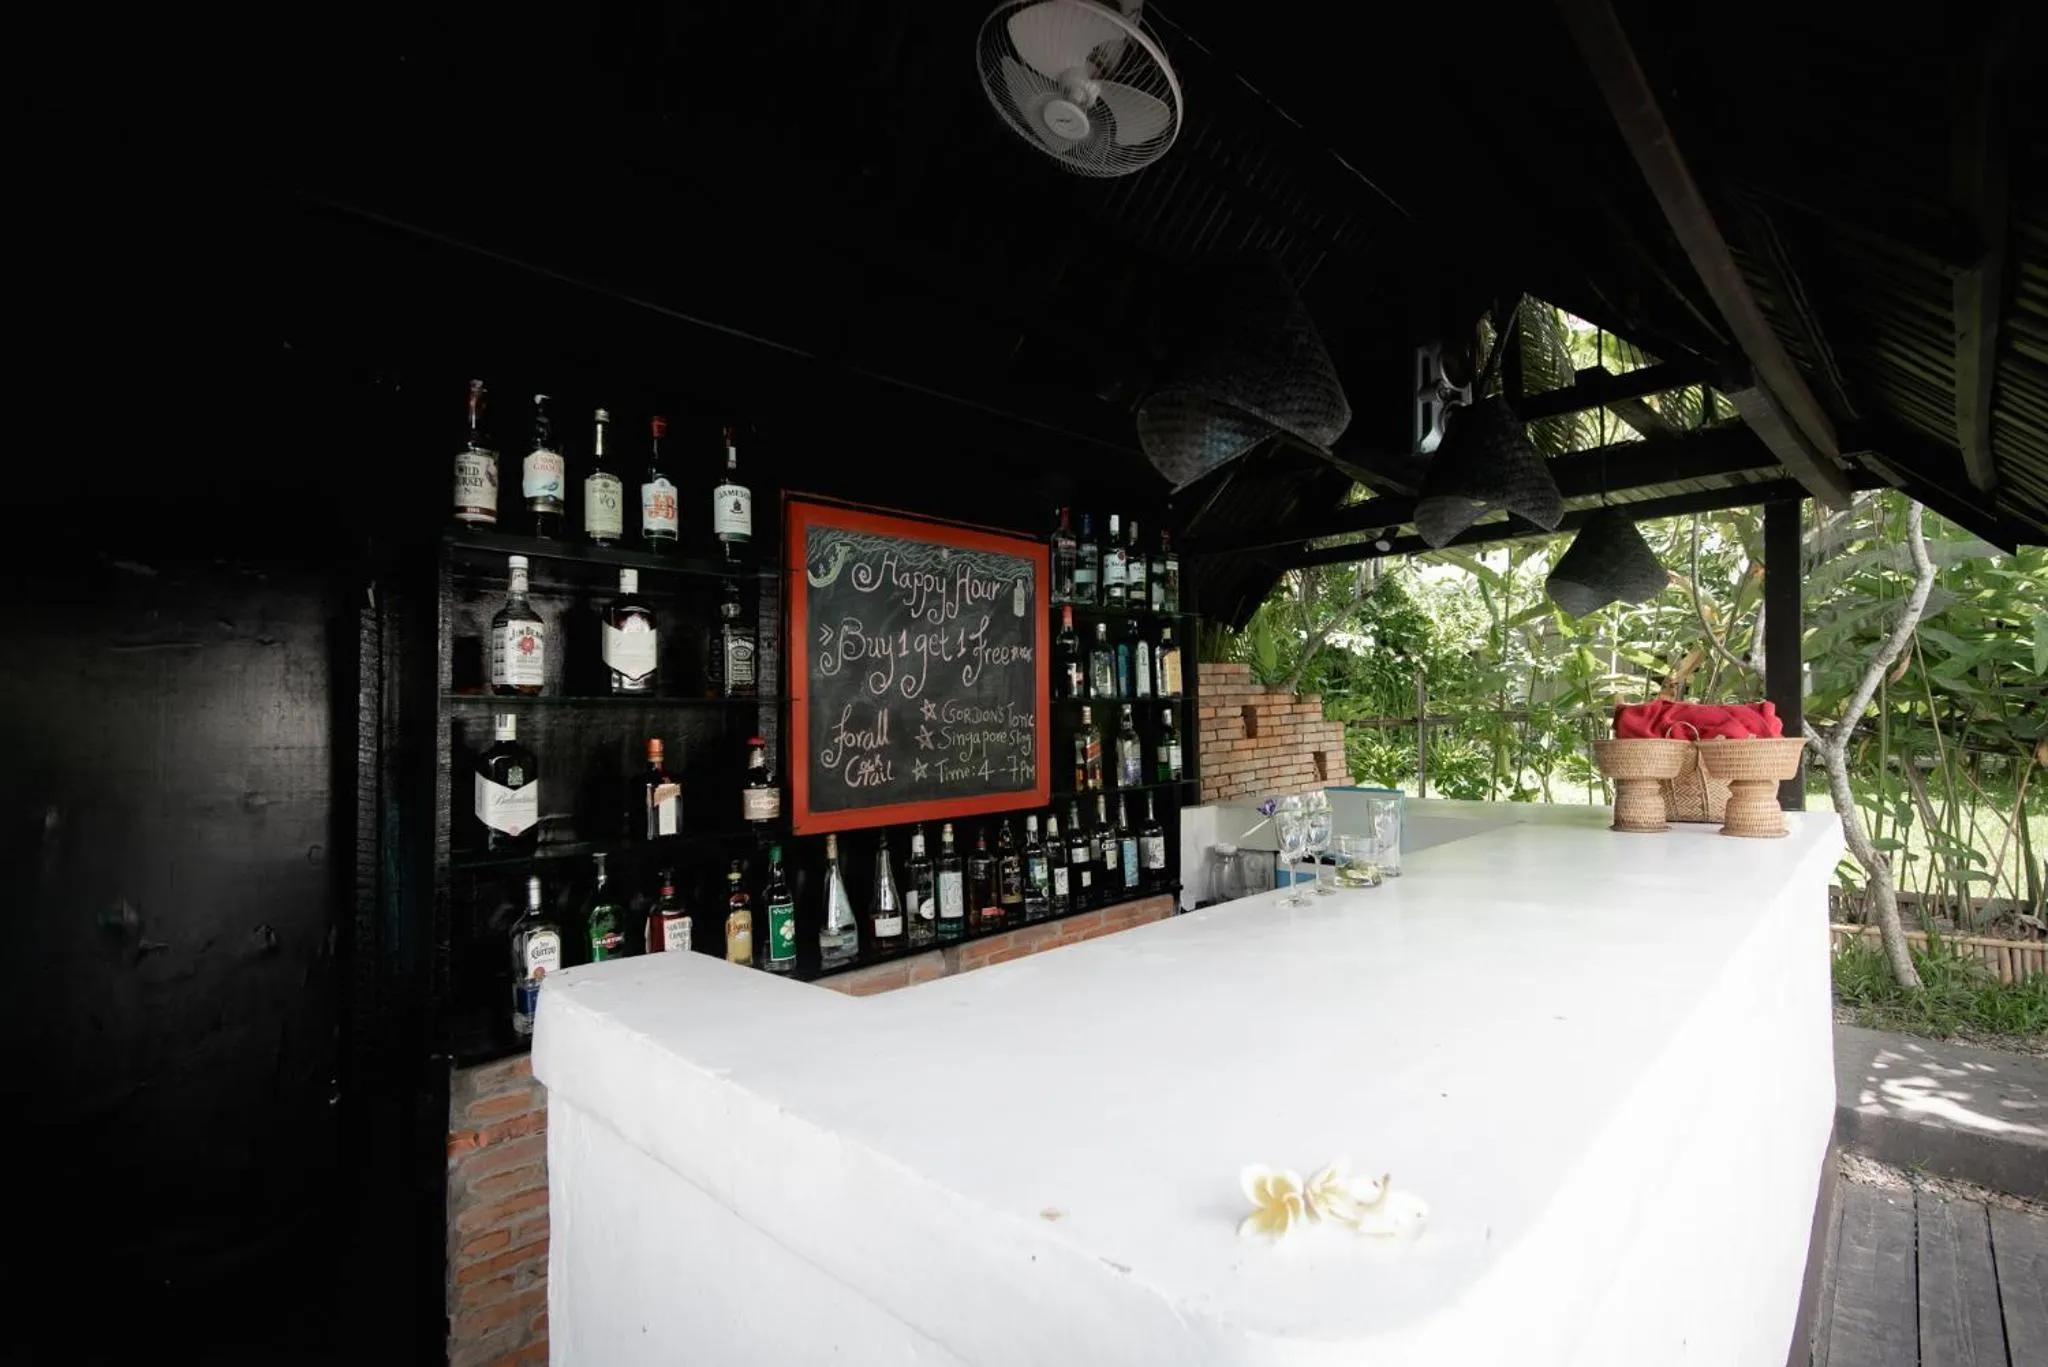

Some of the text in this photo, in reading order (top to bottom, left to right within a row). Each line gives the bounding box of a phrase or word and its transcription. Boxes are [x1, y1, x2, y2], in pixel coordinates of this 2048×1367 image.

[851, 551, 999, 625] Happy Hour
[820, 617, 894, 694] Buy
[898, 629, 909, 657] 1
[899, 627, 953, 698] get
[1006, 702, 1034, 728] Tonic
[937, 725, 1007, 762] Singapore
